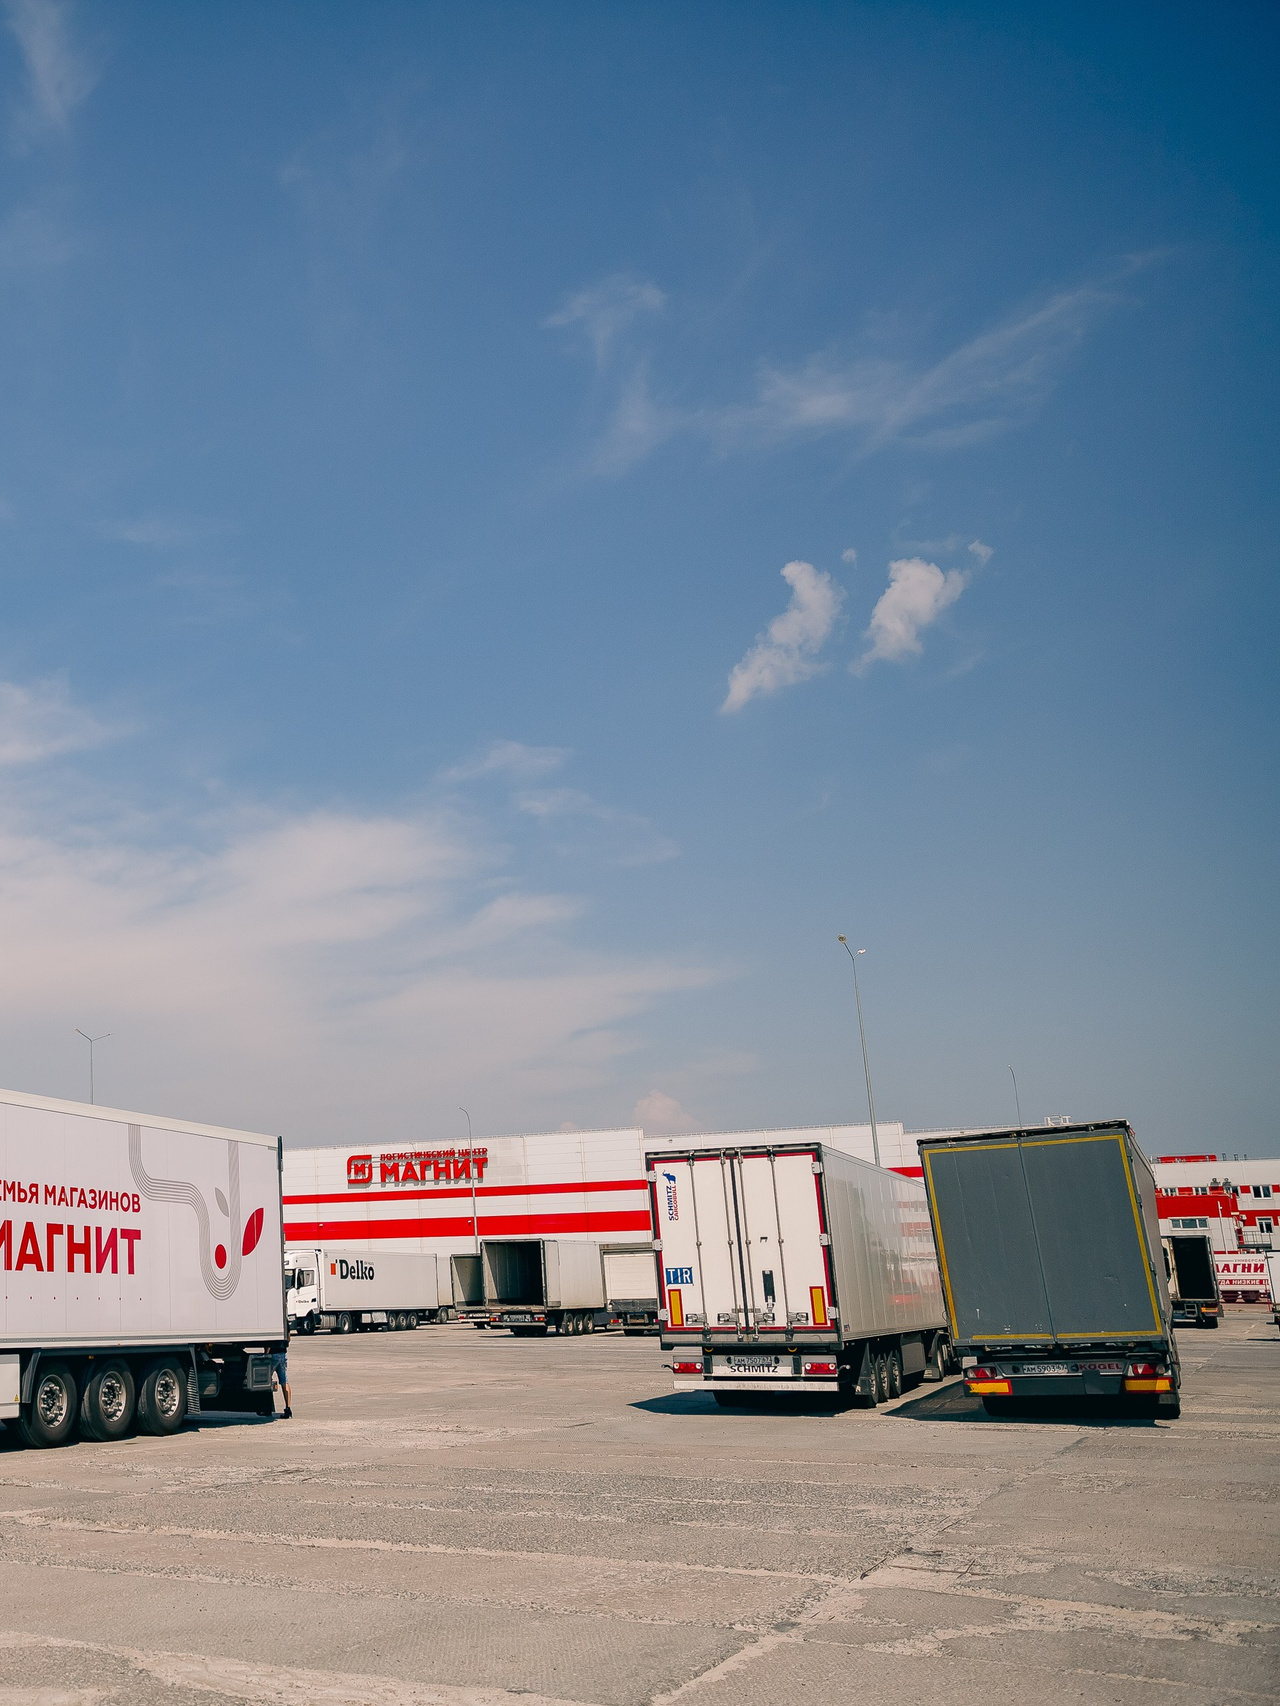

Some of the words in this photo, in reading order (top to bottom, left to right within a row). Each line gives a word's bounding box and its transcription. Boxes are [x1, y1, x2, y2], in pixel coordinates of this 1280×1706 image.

[380, 1148, 455, 1161] ЛОГИСТИЧЕСКИЙ
[458, 1147, 488, 1157] ЦЕНТР
[380, 1157, 488, 1183] МАГНИТ
[44, 1184, 141, 1213] МАГАЗИНОВ
[666, 1186, 674, 1221] SCHMITZ
[339, 1259, 375, 1280] Delko
[667, 1269, 691, 1283] TIR
